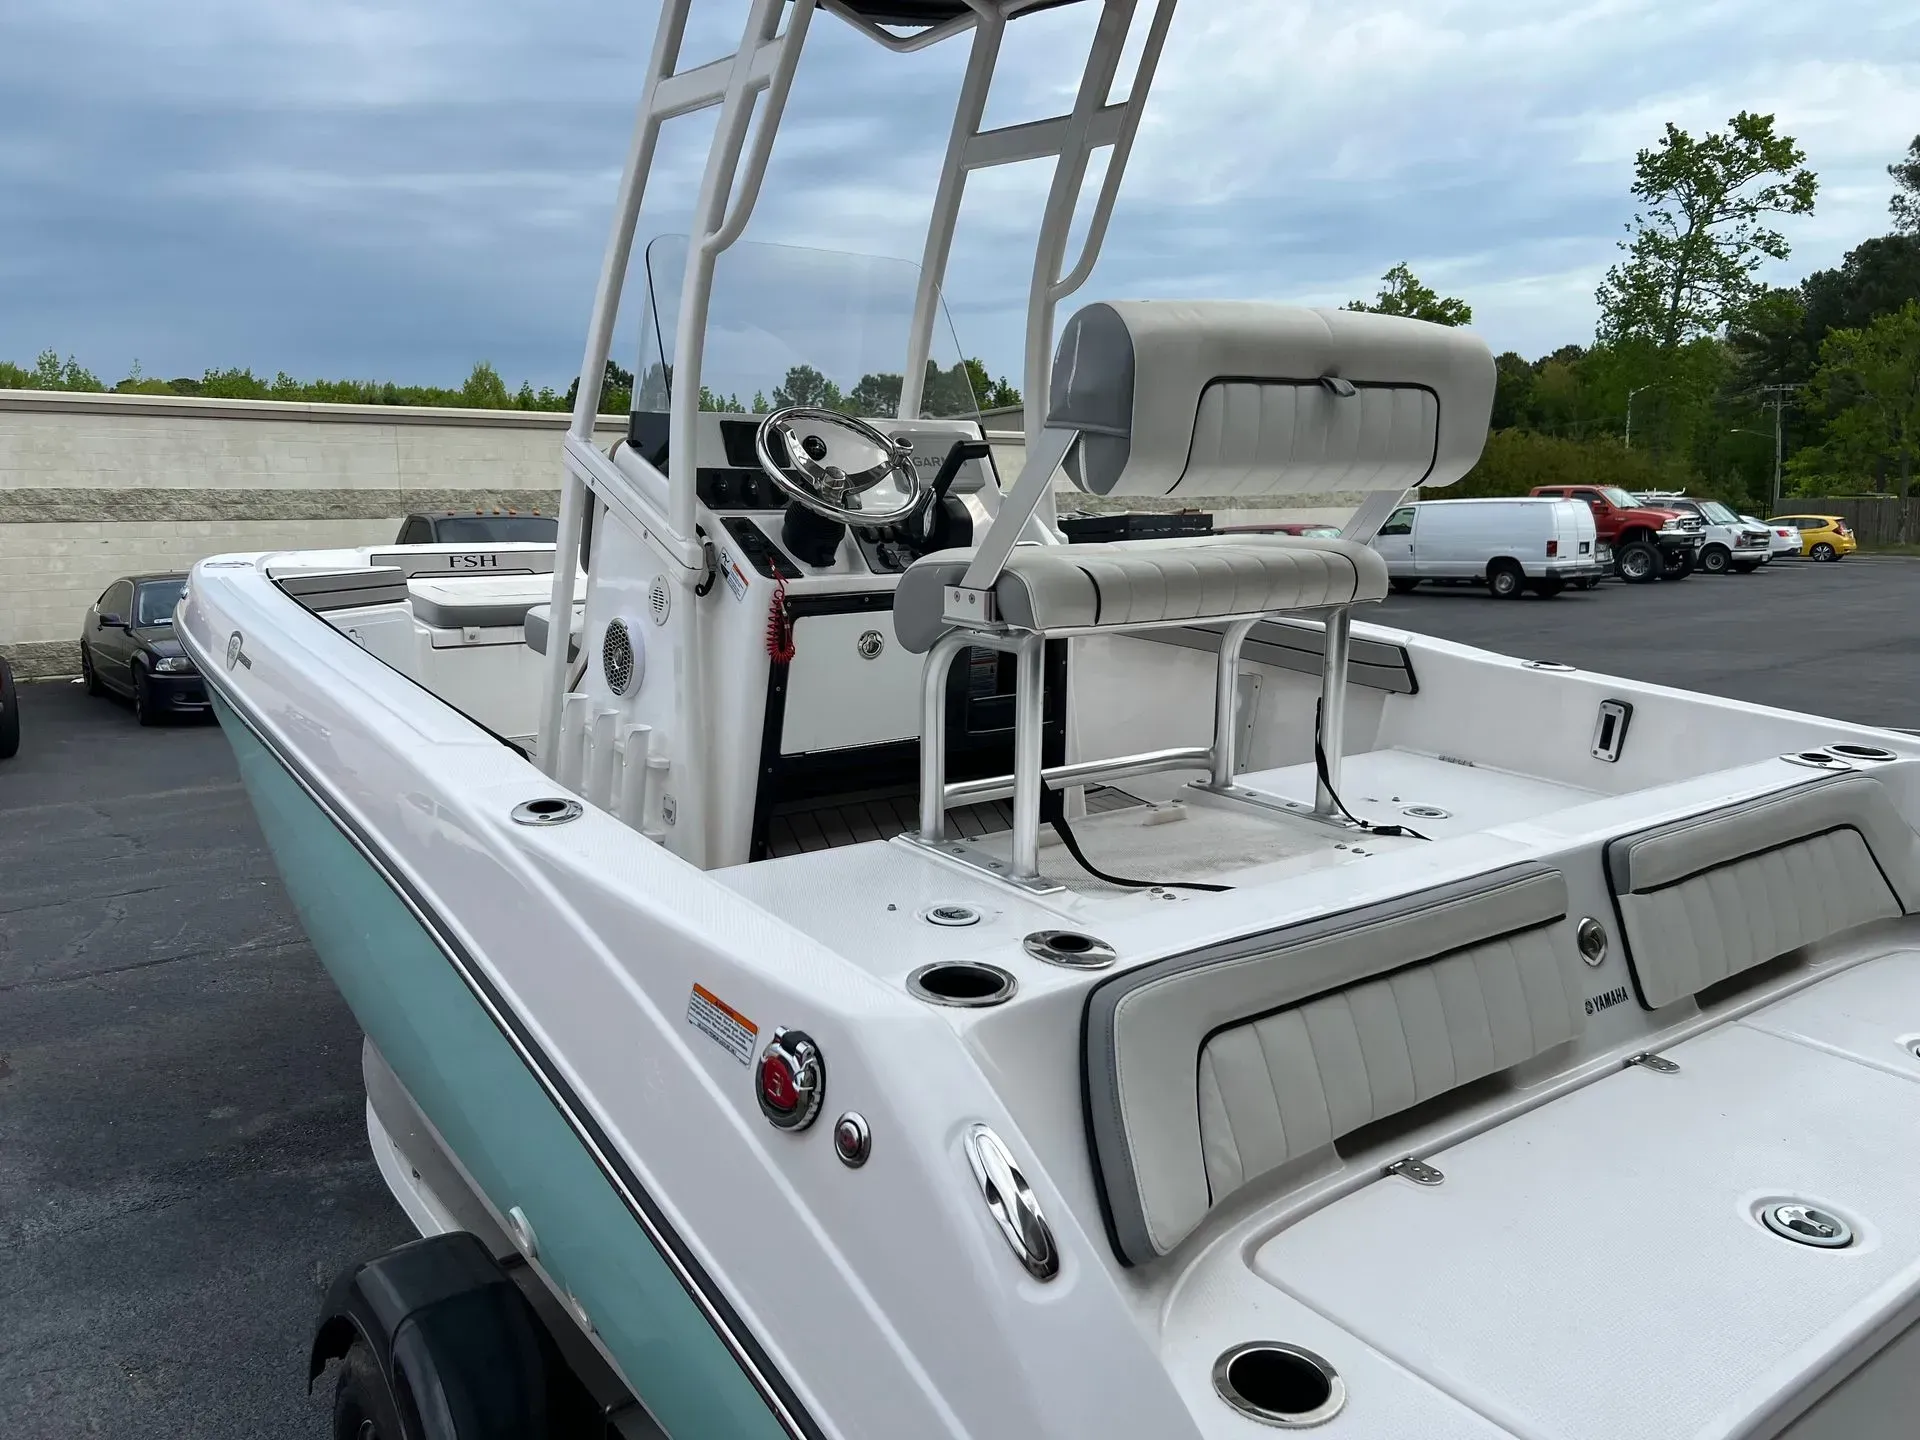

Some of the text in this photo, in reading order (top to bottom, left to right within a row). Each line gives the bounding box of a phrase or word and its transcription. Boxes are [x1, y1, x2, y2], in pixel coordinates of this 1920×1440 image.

[912, 456, 968, 467] GAR
[449, 555, 498, 568] FSH
[1592, 986, 1629, 1012] YAMAHA
